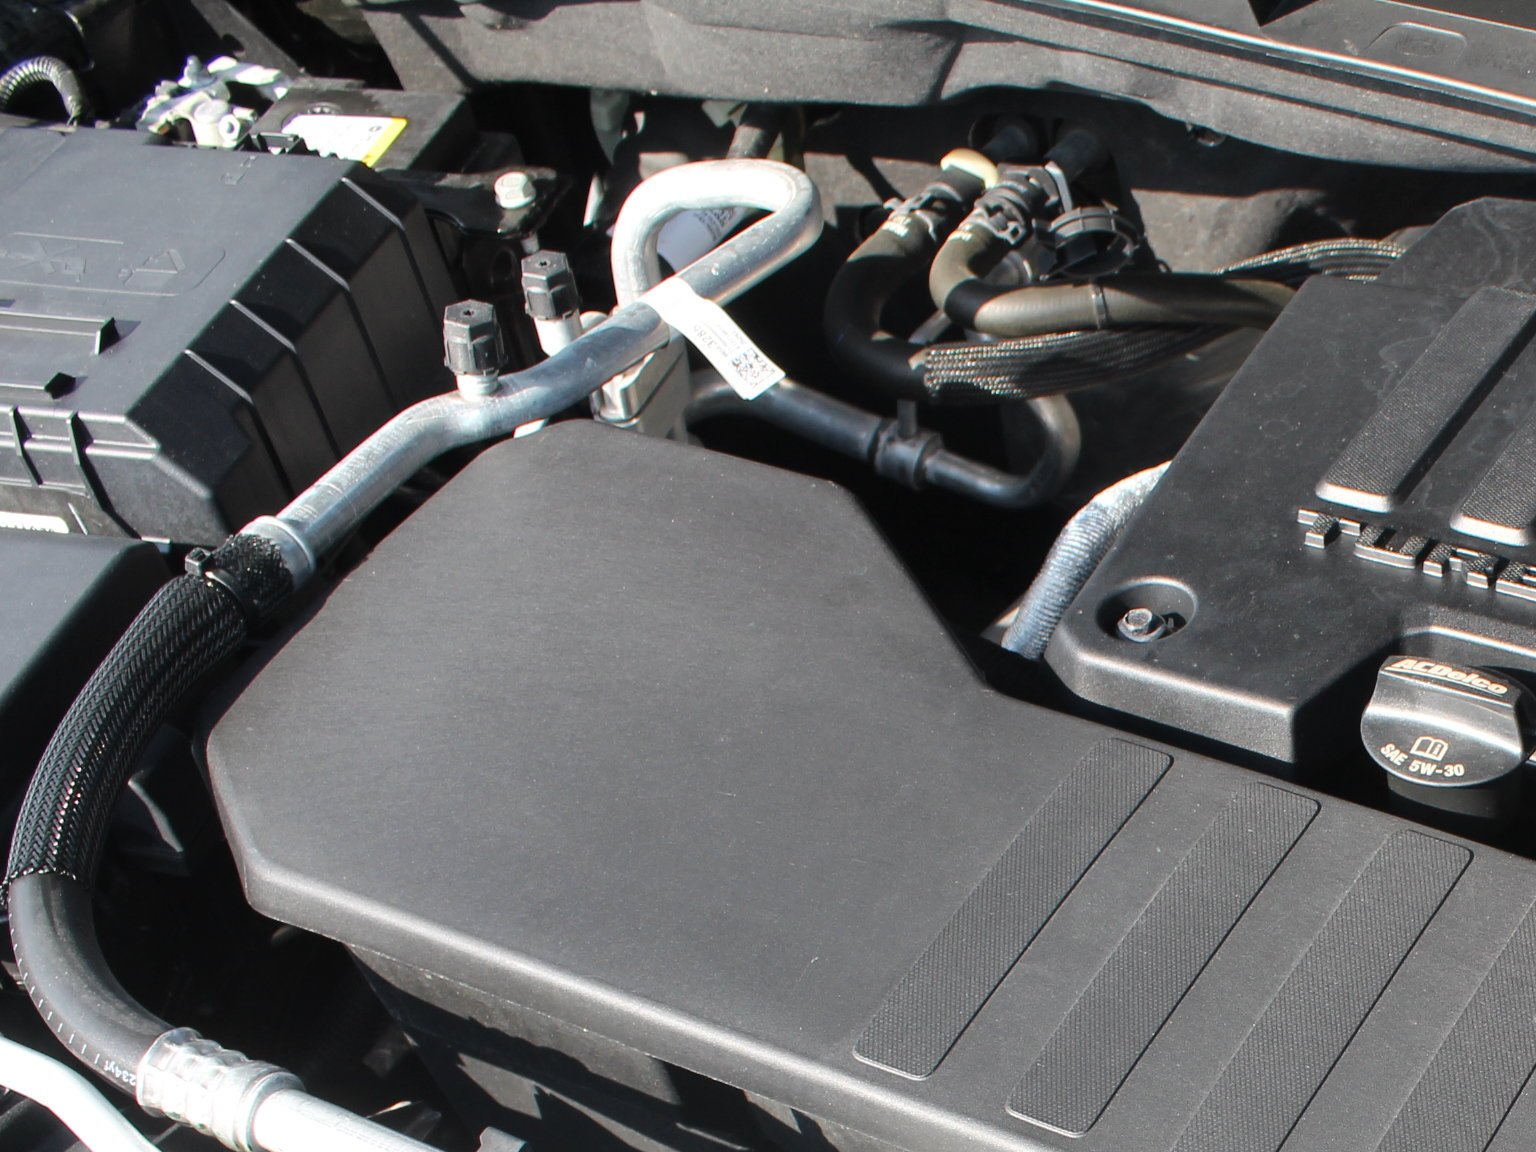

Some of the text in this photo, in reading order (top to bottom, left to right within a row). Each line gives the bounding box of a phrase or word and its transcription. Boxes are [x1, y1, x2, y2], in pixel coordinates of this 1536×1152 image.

[1393, 658, 1509, 696] ACDelco
[1380, 743, 1465, 778] SAE 5W-30
